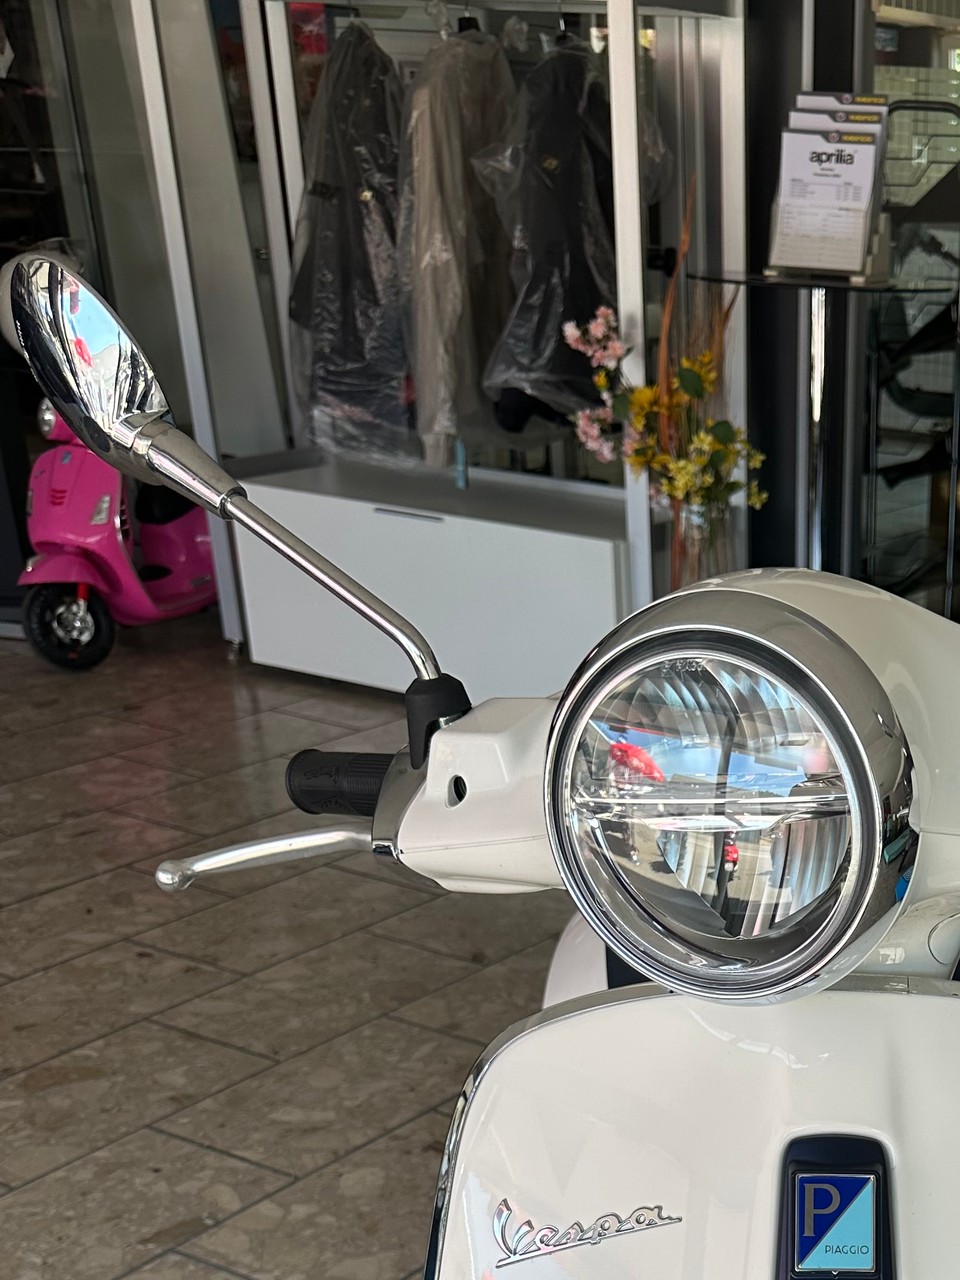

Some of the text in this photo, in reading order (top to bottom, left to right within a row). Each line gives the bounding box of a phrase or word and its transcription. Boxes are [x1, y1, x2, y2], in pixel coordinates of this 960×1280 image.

[809, 148, 855, 166] aprilia
[802, 1183, 841, 1237] P
[492, 1197, 683, 1269] Vespa
[824, 1245, 870, 1255] PIAGGIO
